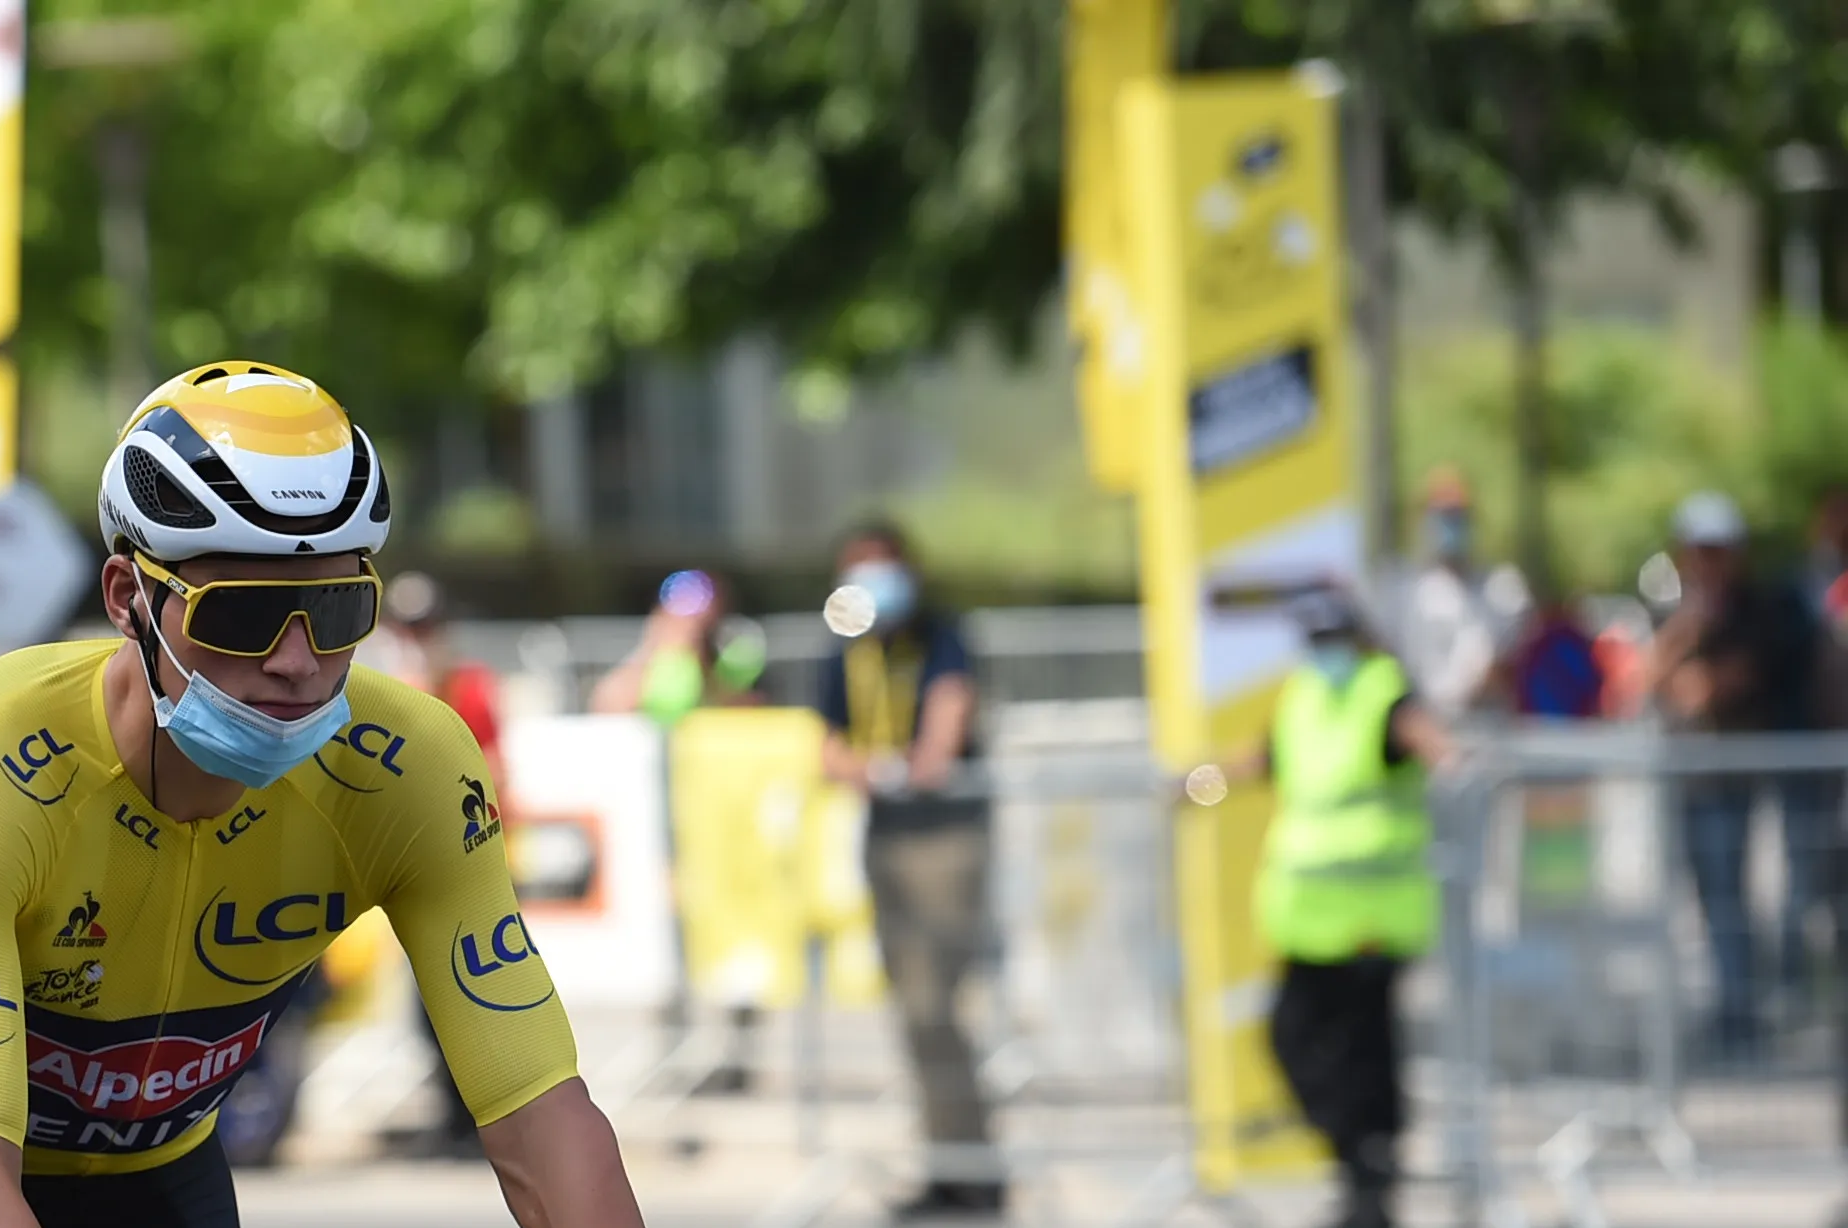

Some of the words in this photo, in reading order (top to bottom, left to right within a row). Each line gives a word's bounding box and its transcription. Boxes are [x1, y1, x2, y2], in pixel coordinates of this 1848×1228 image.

[271, 489, 326, 500] CANYON
[2, 728, 75, 783] LCL
[115, 803, 160, 850] LCL
[215, 805, 266, 845] LCL
[214, 892, 353, 945] LCL
[29, 1041, 243, 1110] Alpecin
[27, 1089, 228, 1148] ENIX
